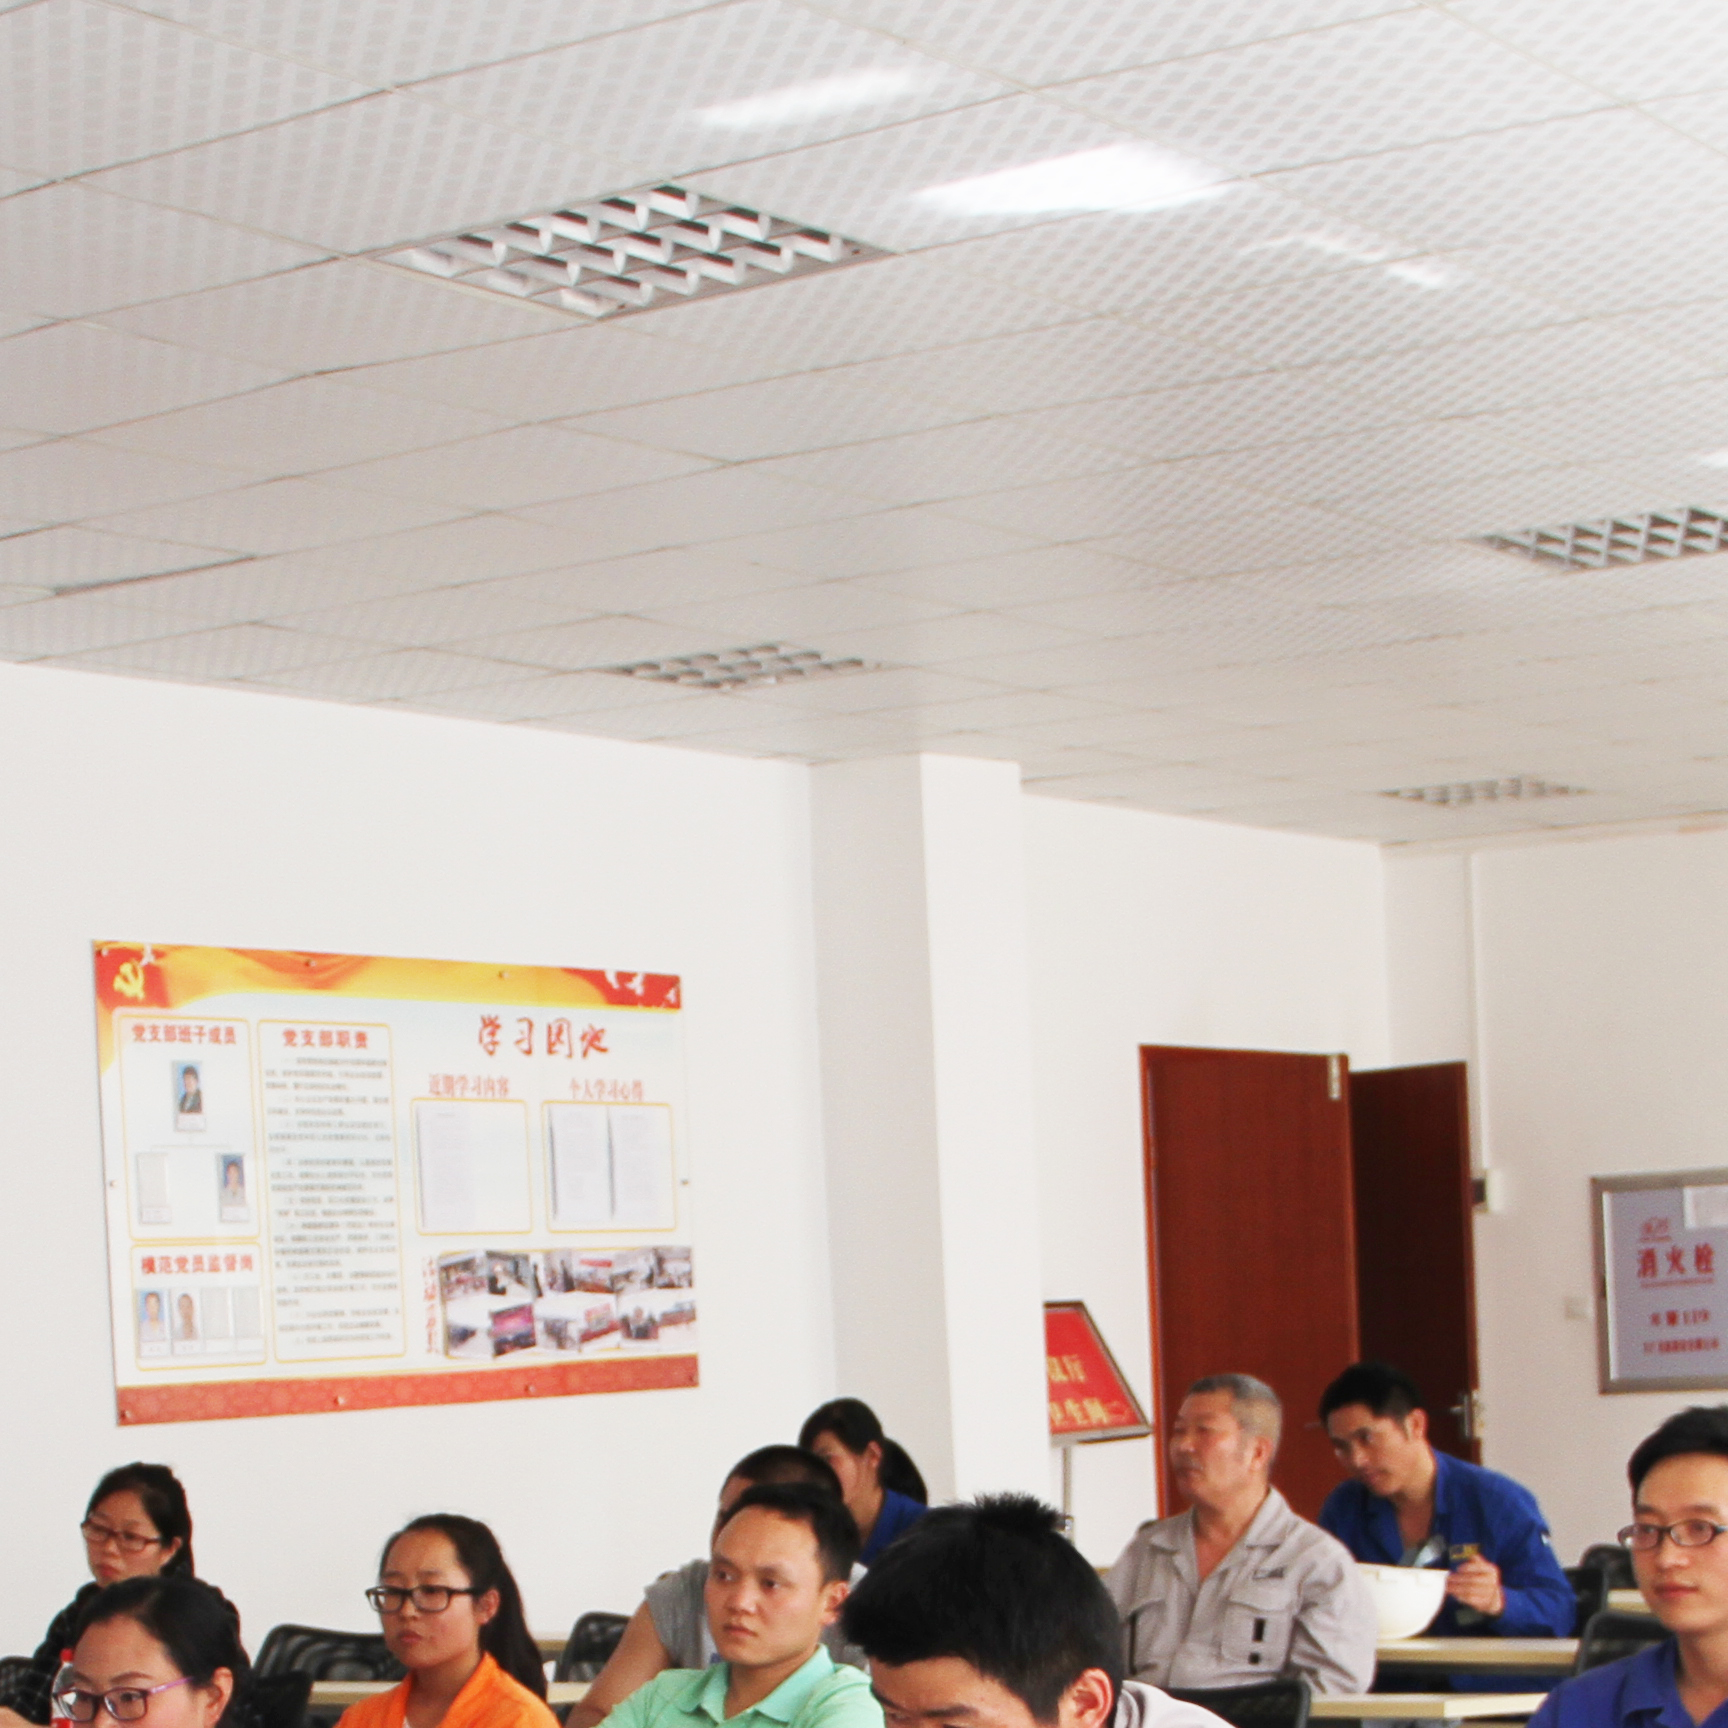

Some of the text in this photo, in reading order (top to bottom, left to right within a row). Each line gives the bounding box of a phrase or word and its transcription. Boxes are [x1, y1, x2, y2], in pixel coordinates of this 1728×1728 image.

[132, 1023, 236, 1045] 党支部班子成员
